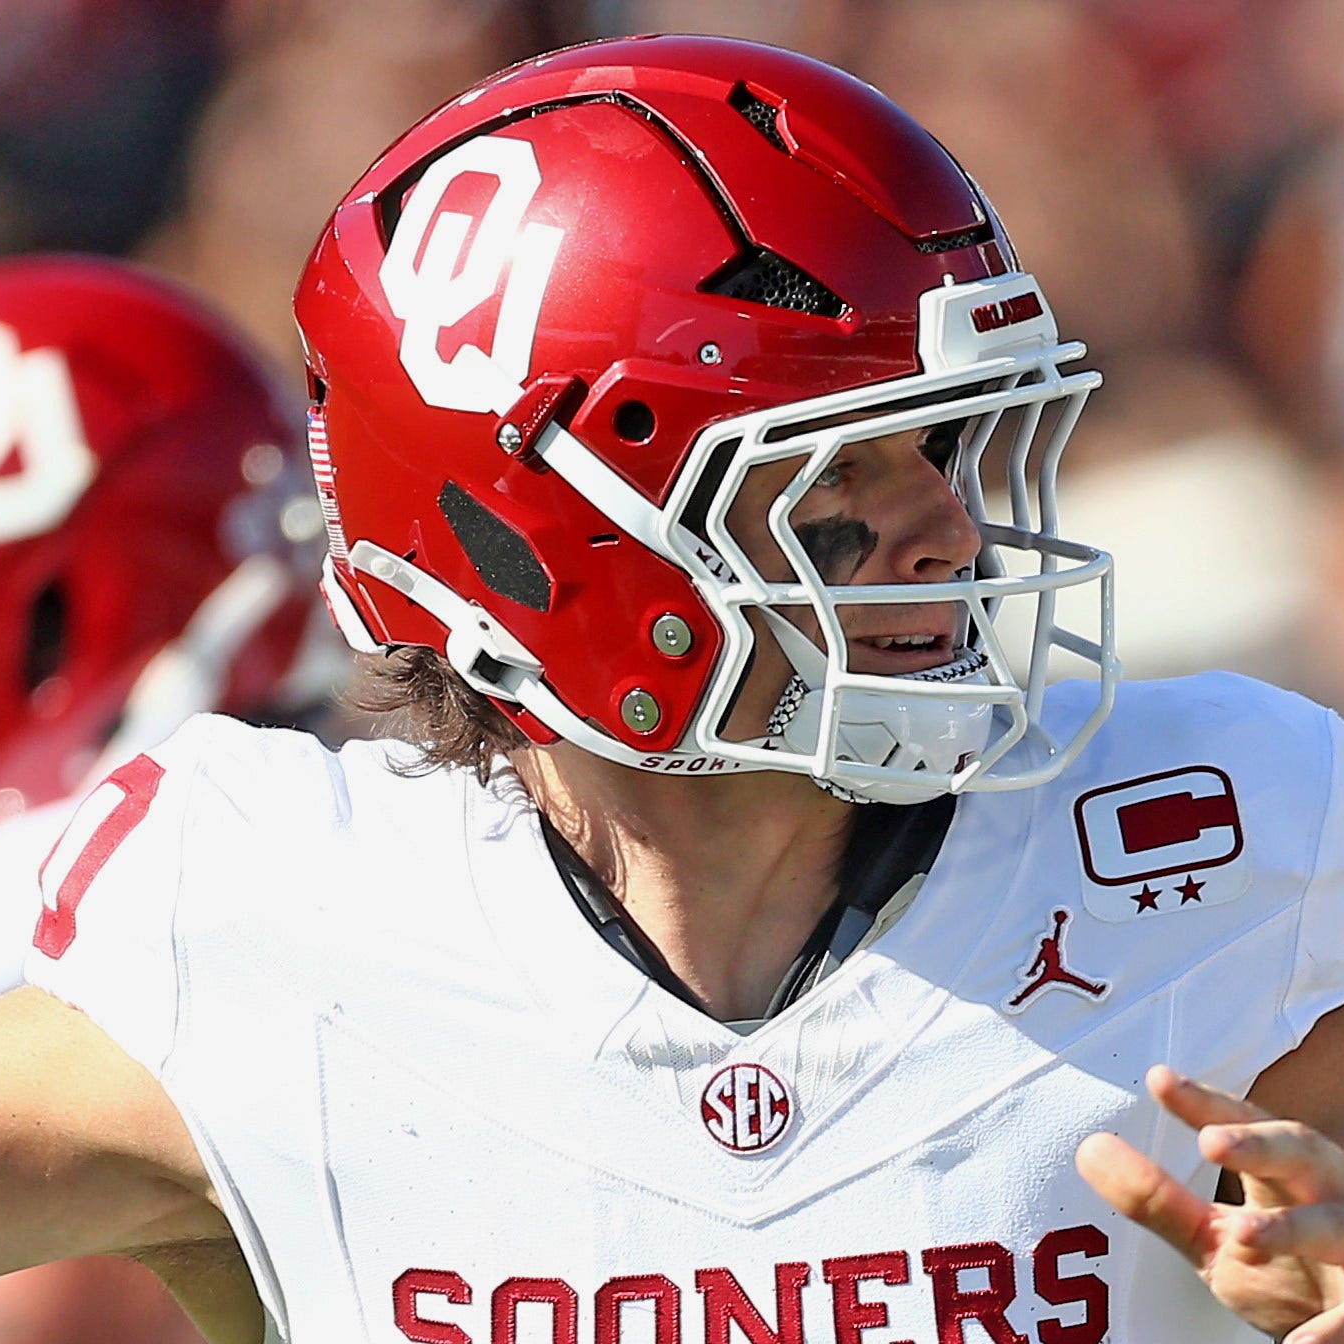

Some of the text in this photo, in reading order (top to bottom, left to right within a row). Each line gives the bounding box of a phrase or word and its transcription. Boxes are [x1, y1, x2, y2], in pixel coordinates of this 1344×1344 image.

[378, 135, 565, 417] OU
[639, 756, 741, 772] SPOR
[701, 1063, 789, 1151] SEC
